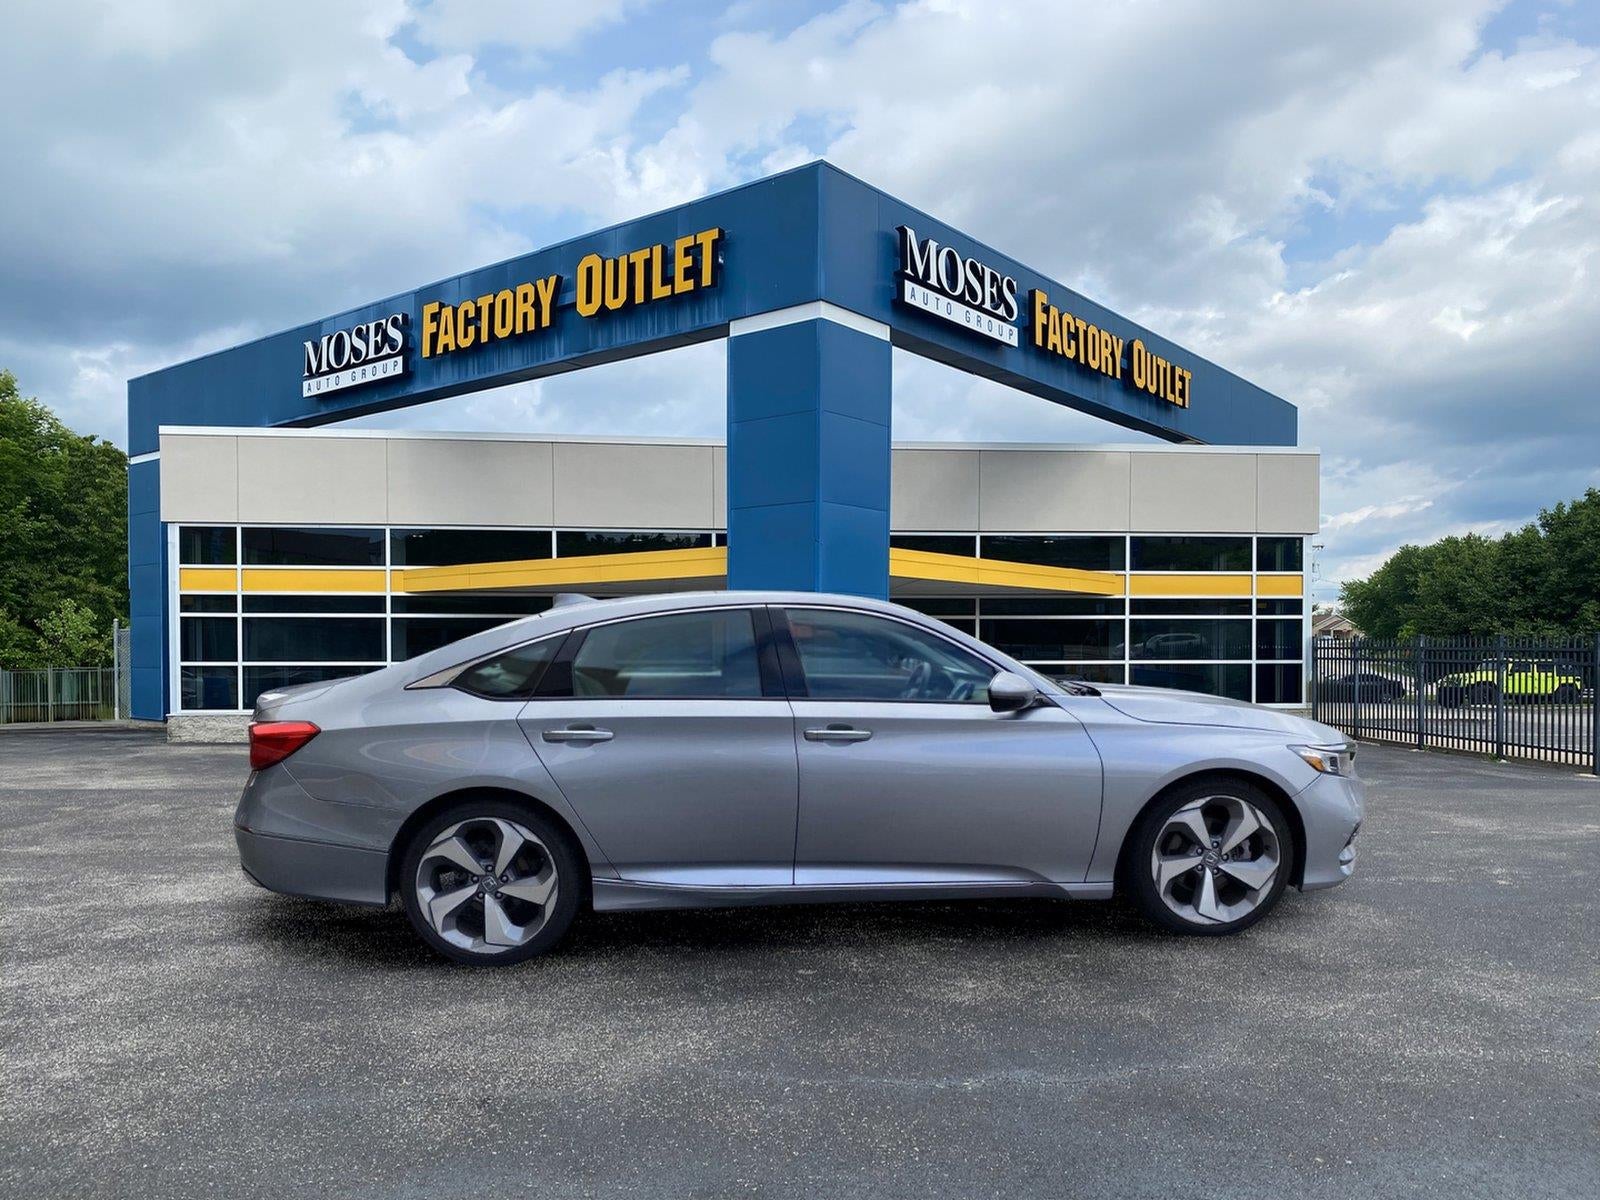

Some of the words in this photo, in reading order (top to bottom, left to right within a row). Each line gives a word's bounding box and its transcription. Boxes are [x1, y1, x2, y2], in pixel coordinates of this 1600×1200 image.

[421, 274, 559, 358] FACTORY
[576, 227, 720, 318] OUTLET
[903, 225, 1019, 322] MOSES
[909, 286, 953, 316] AUTO
[965, 310, 1016, 340] GROUP
[303, 313, 404, 377] MOSES
[306, 374, 341, 394] AUTO
[350, 360, 400, 383] GROUP
[1034, 288, 1124, 379] FACTORY
[1133, 339, 1193, 409] OUTLET
